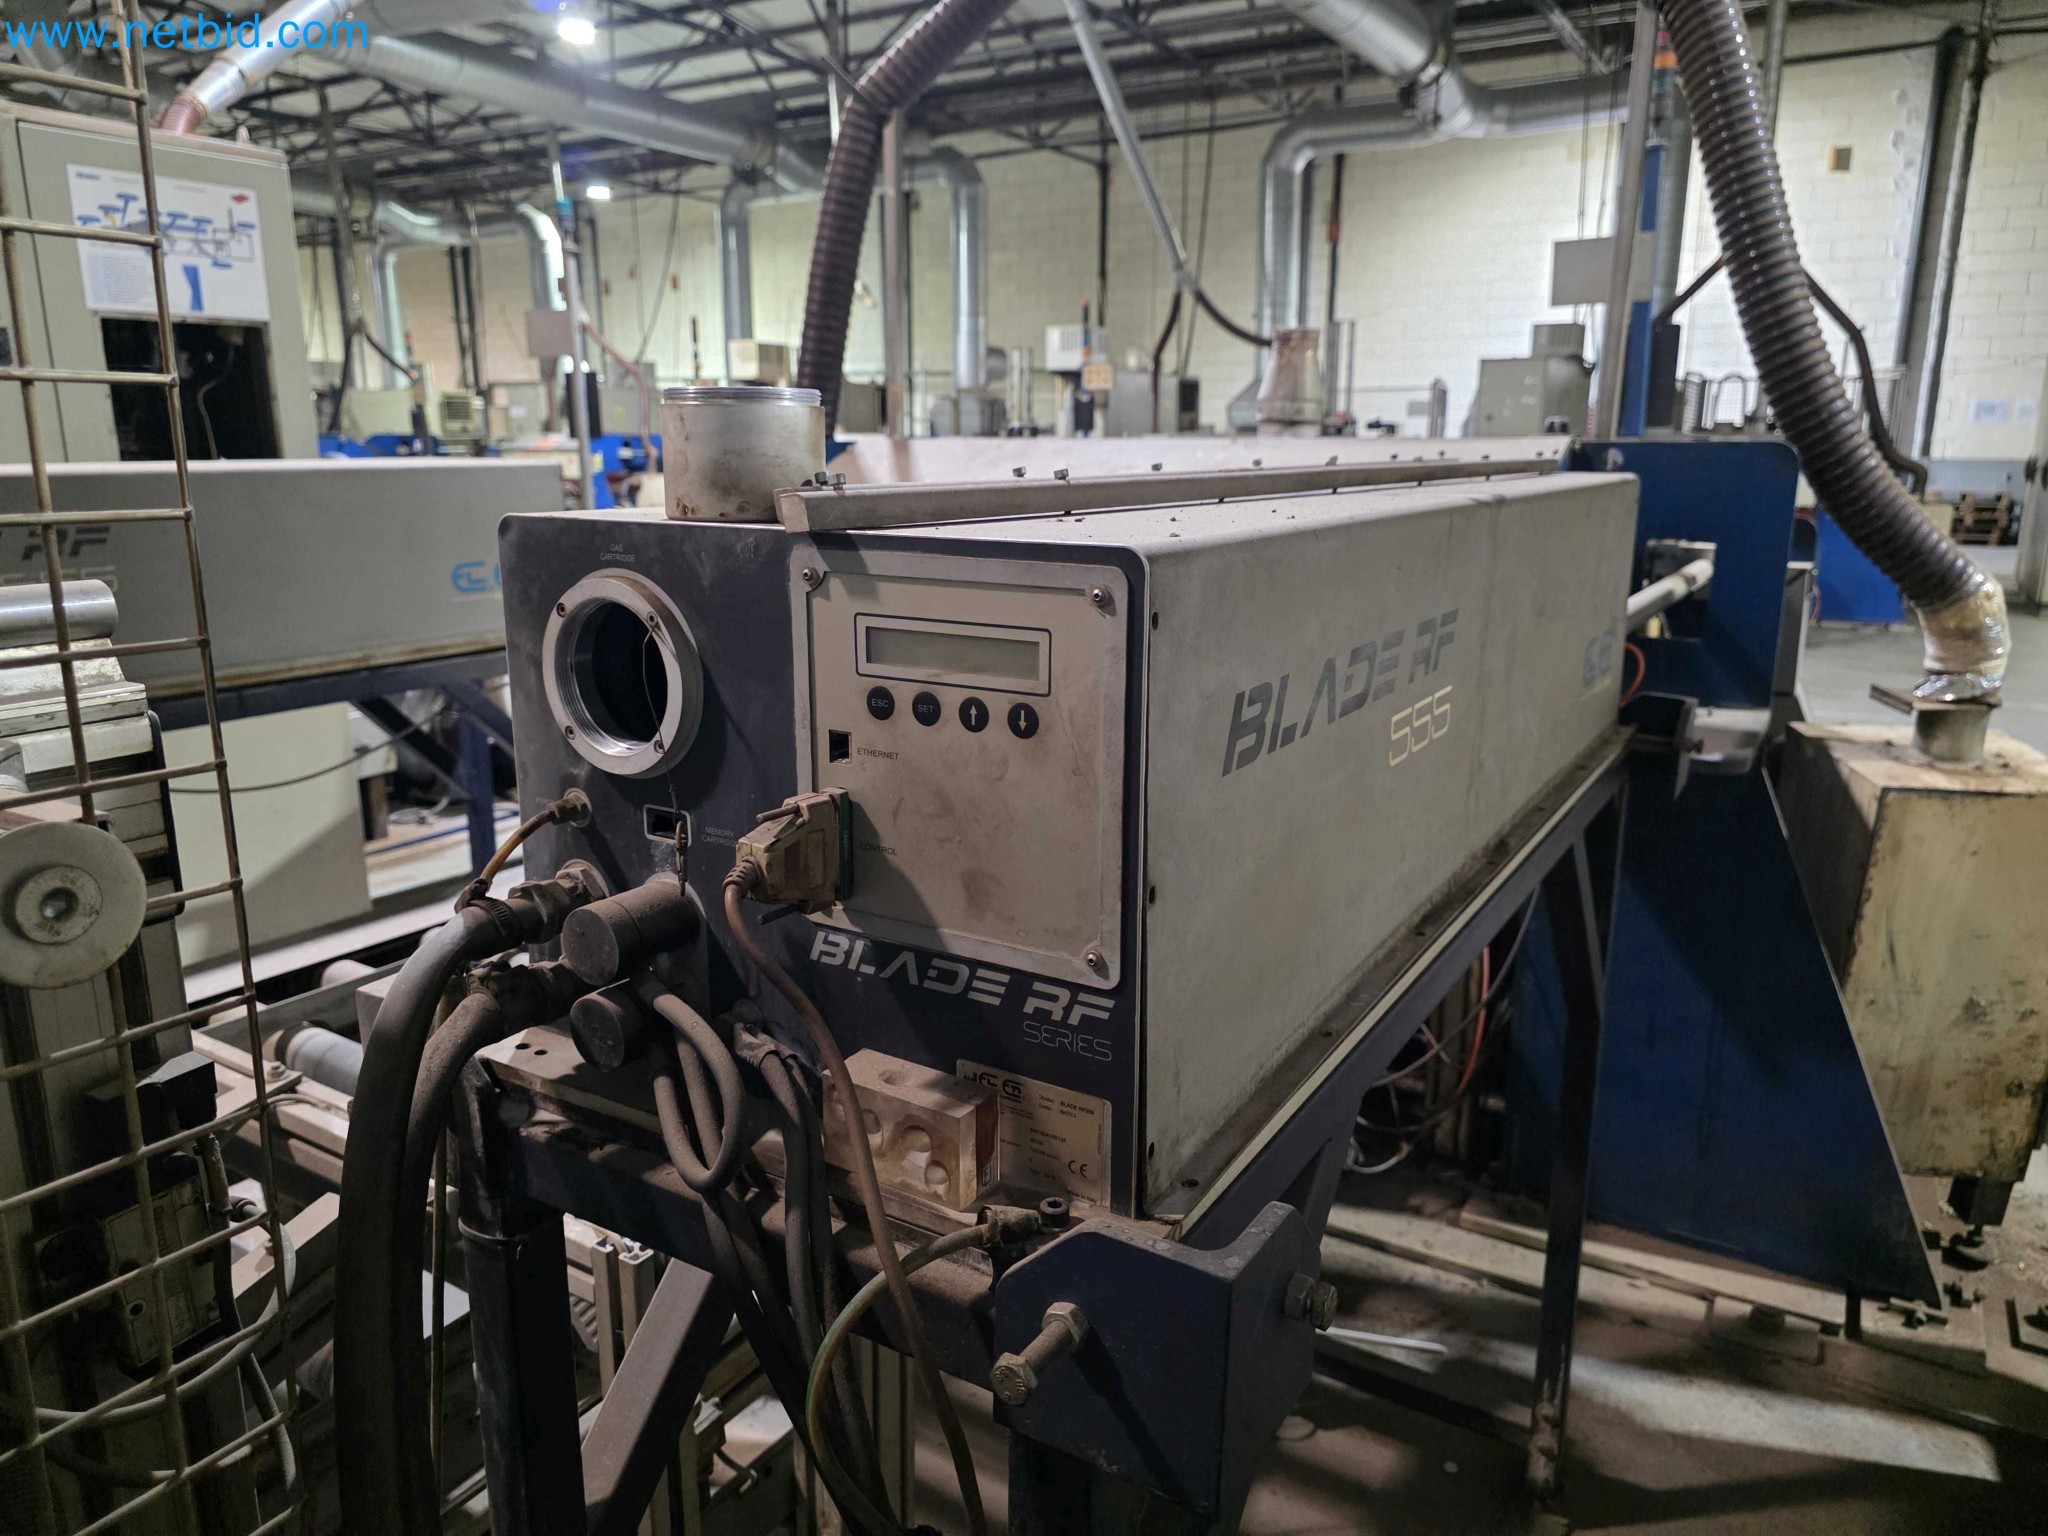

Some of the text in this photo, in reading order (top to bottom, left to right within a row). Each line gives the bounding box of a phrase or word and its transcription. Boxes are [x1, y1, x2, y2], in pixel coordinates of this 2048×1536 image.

[600, 552, 636, 563] CARTRIDGE
[1222, 629, 1405, 778] BLADE
[1408, 608, 1459, 684] RF
[872, 697, 889, 708] ESC
[917, 705, 935, 713] SET
[1388, 685, 1454, 767] 555
[857, 747, 900, 760] ETHERNET
[705, 826, 735, 839] MEMORY
[859, 842, 898, 856] CONTROL
[809, 930, 1116, 1027] BLADE RF
[1022, 1020, 1113, 1062] SERIES
